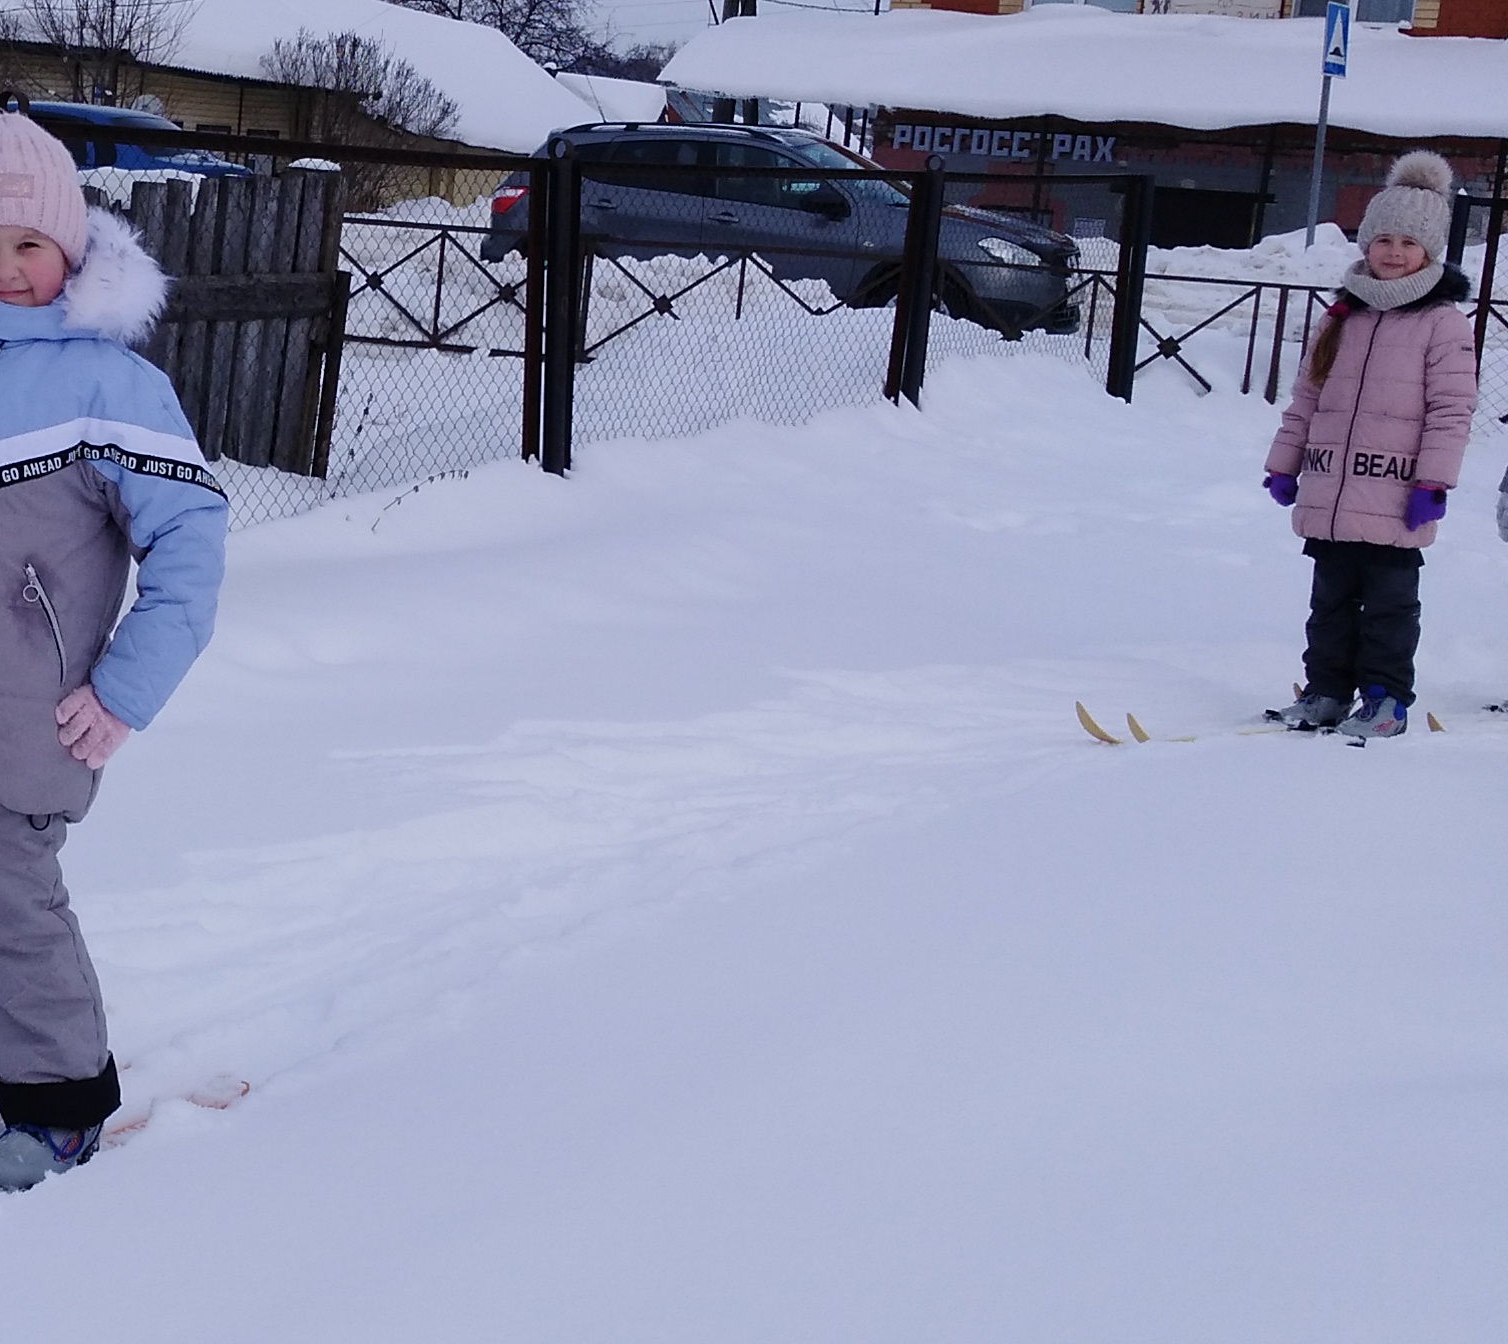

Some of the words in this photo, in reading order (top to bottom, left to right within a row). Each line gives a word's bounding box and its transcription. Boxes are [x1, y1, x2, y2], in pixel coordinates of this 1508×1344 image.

[892, 124, 1117, 162] РОСГОССРАХ
[1, 467, 20, 483] GO
[23, 457, 62, 478] AHEAD
[83, 447, 100, 460] GO
[142, 459, 174, 476] JUST
[176, 466, 193, 480] GO
[1353, 452, 1418, 482] BEAU
